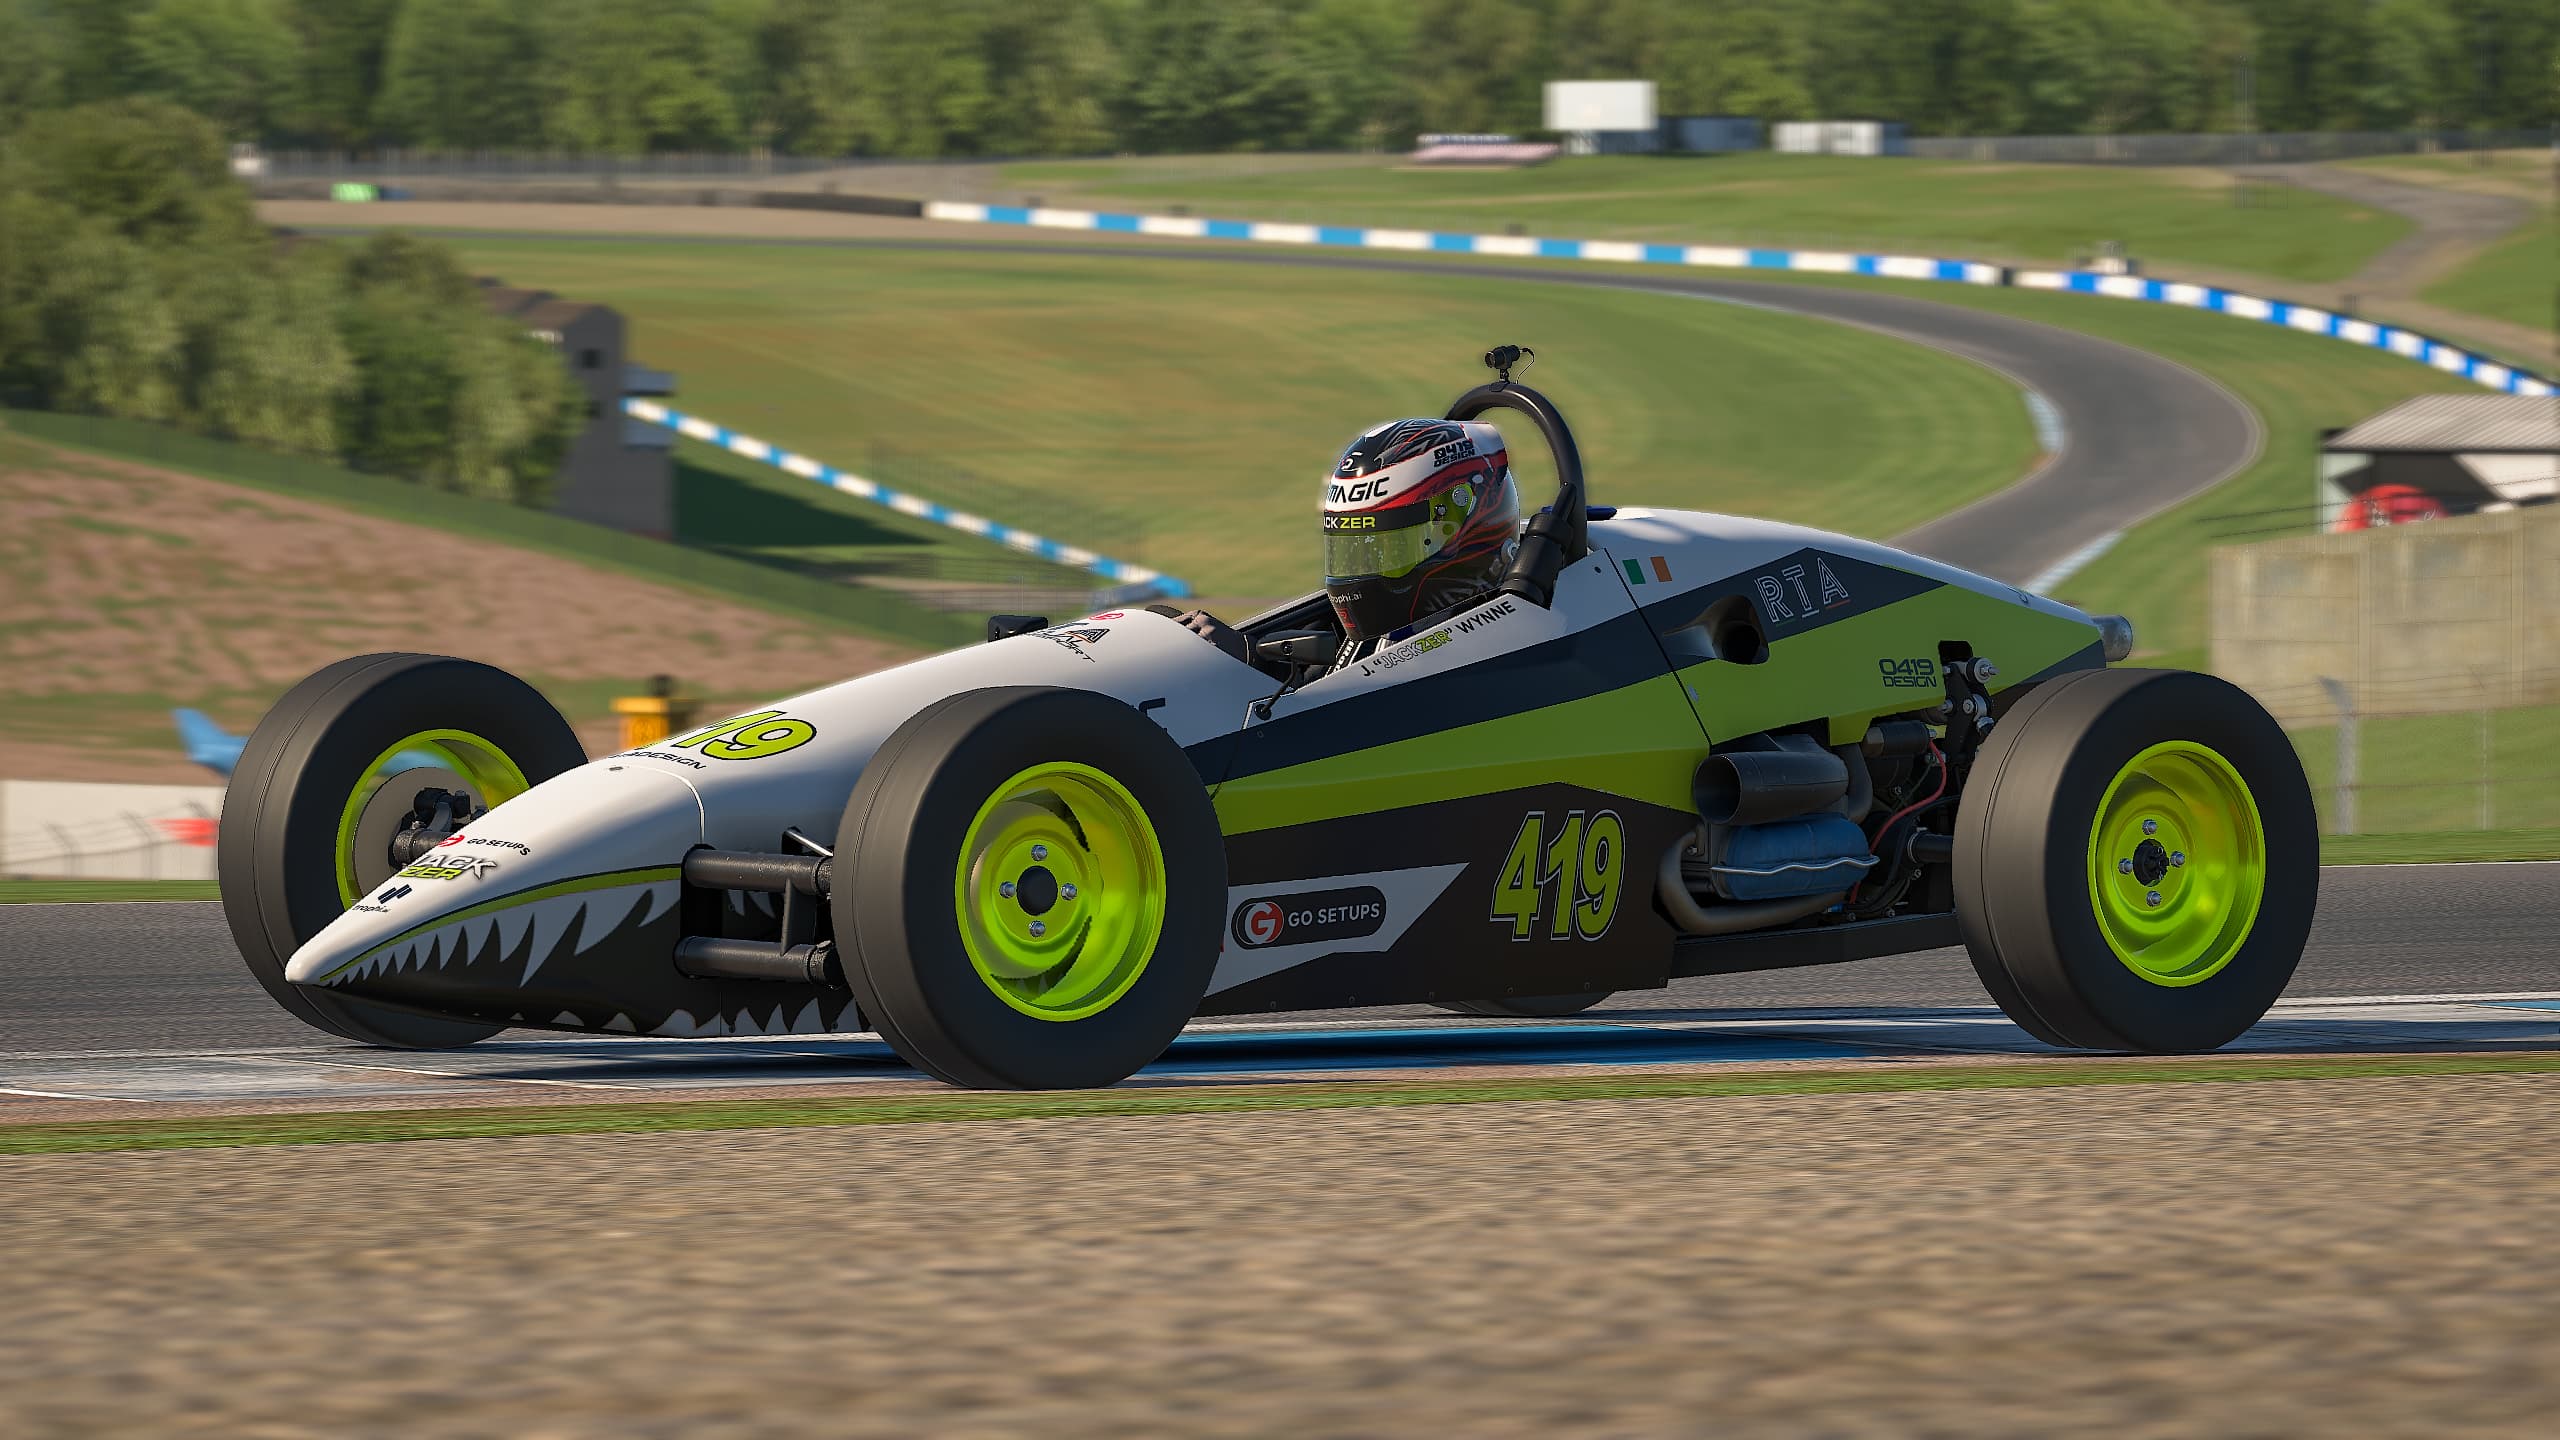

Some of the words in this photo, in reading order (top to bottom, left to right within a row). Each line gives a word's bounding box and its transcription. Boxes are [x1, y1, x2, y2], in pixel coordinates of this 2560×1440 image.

[1433, 449, 1475, 467] DESIGN
[1754, 555, 1850, 625] RTA
[1360, 664, 1375, 677] J.
[1455, 601, 1517, 634] WYNNE
[1878, 658, 1935, 676] 0419
[1882, 676, 1937, 689] DESIGN
[660, 710, 817, 760] 19
[486, 839, 531, 856] SETUPS
[398, 865, 463, 880] ZER
[1489, 809, 1626, 942] 419
[1288, 910, 1313, 927] GO
[1317, 903, 1380, 924] SETUPS
